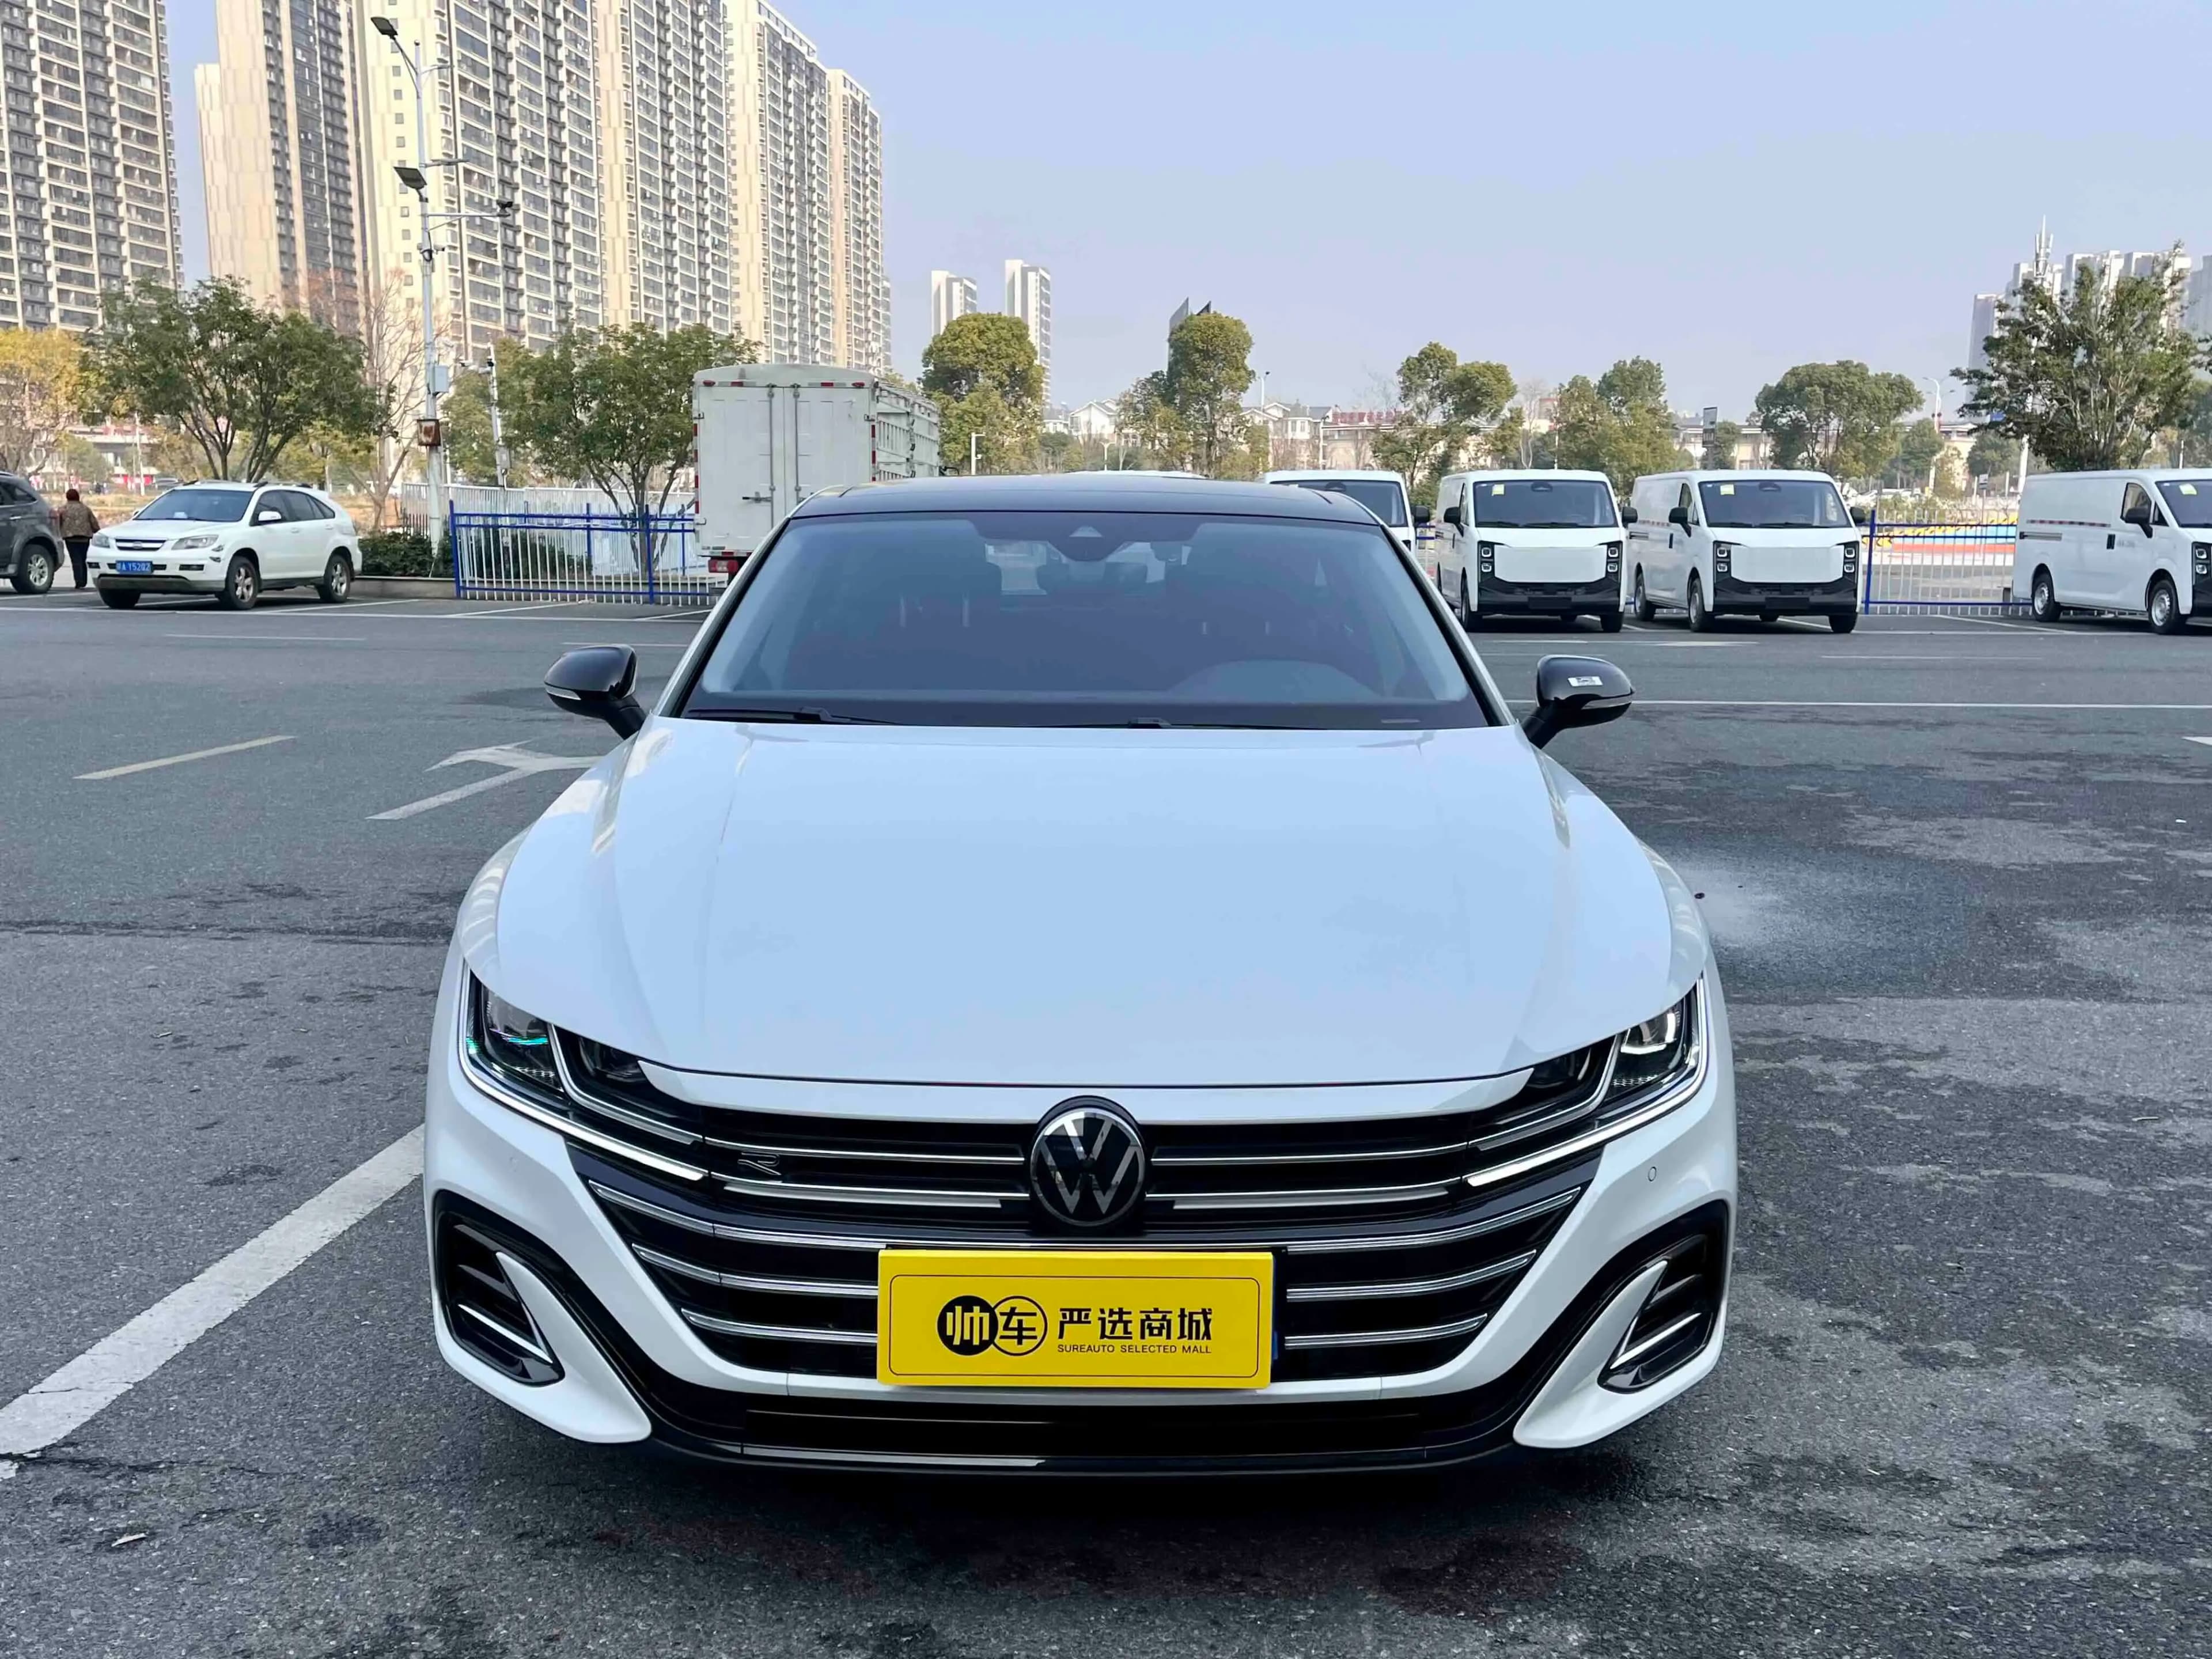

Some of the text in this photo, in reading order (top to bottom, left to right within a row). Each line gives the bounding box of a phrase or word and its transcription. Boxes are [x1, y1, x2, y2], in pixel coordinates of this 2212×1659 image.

[946, 1306, 1212, 1345] 帅车 严选商城
[1058, 1344, 1211, 1354] SUREAUTO SELECTED MALL
